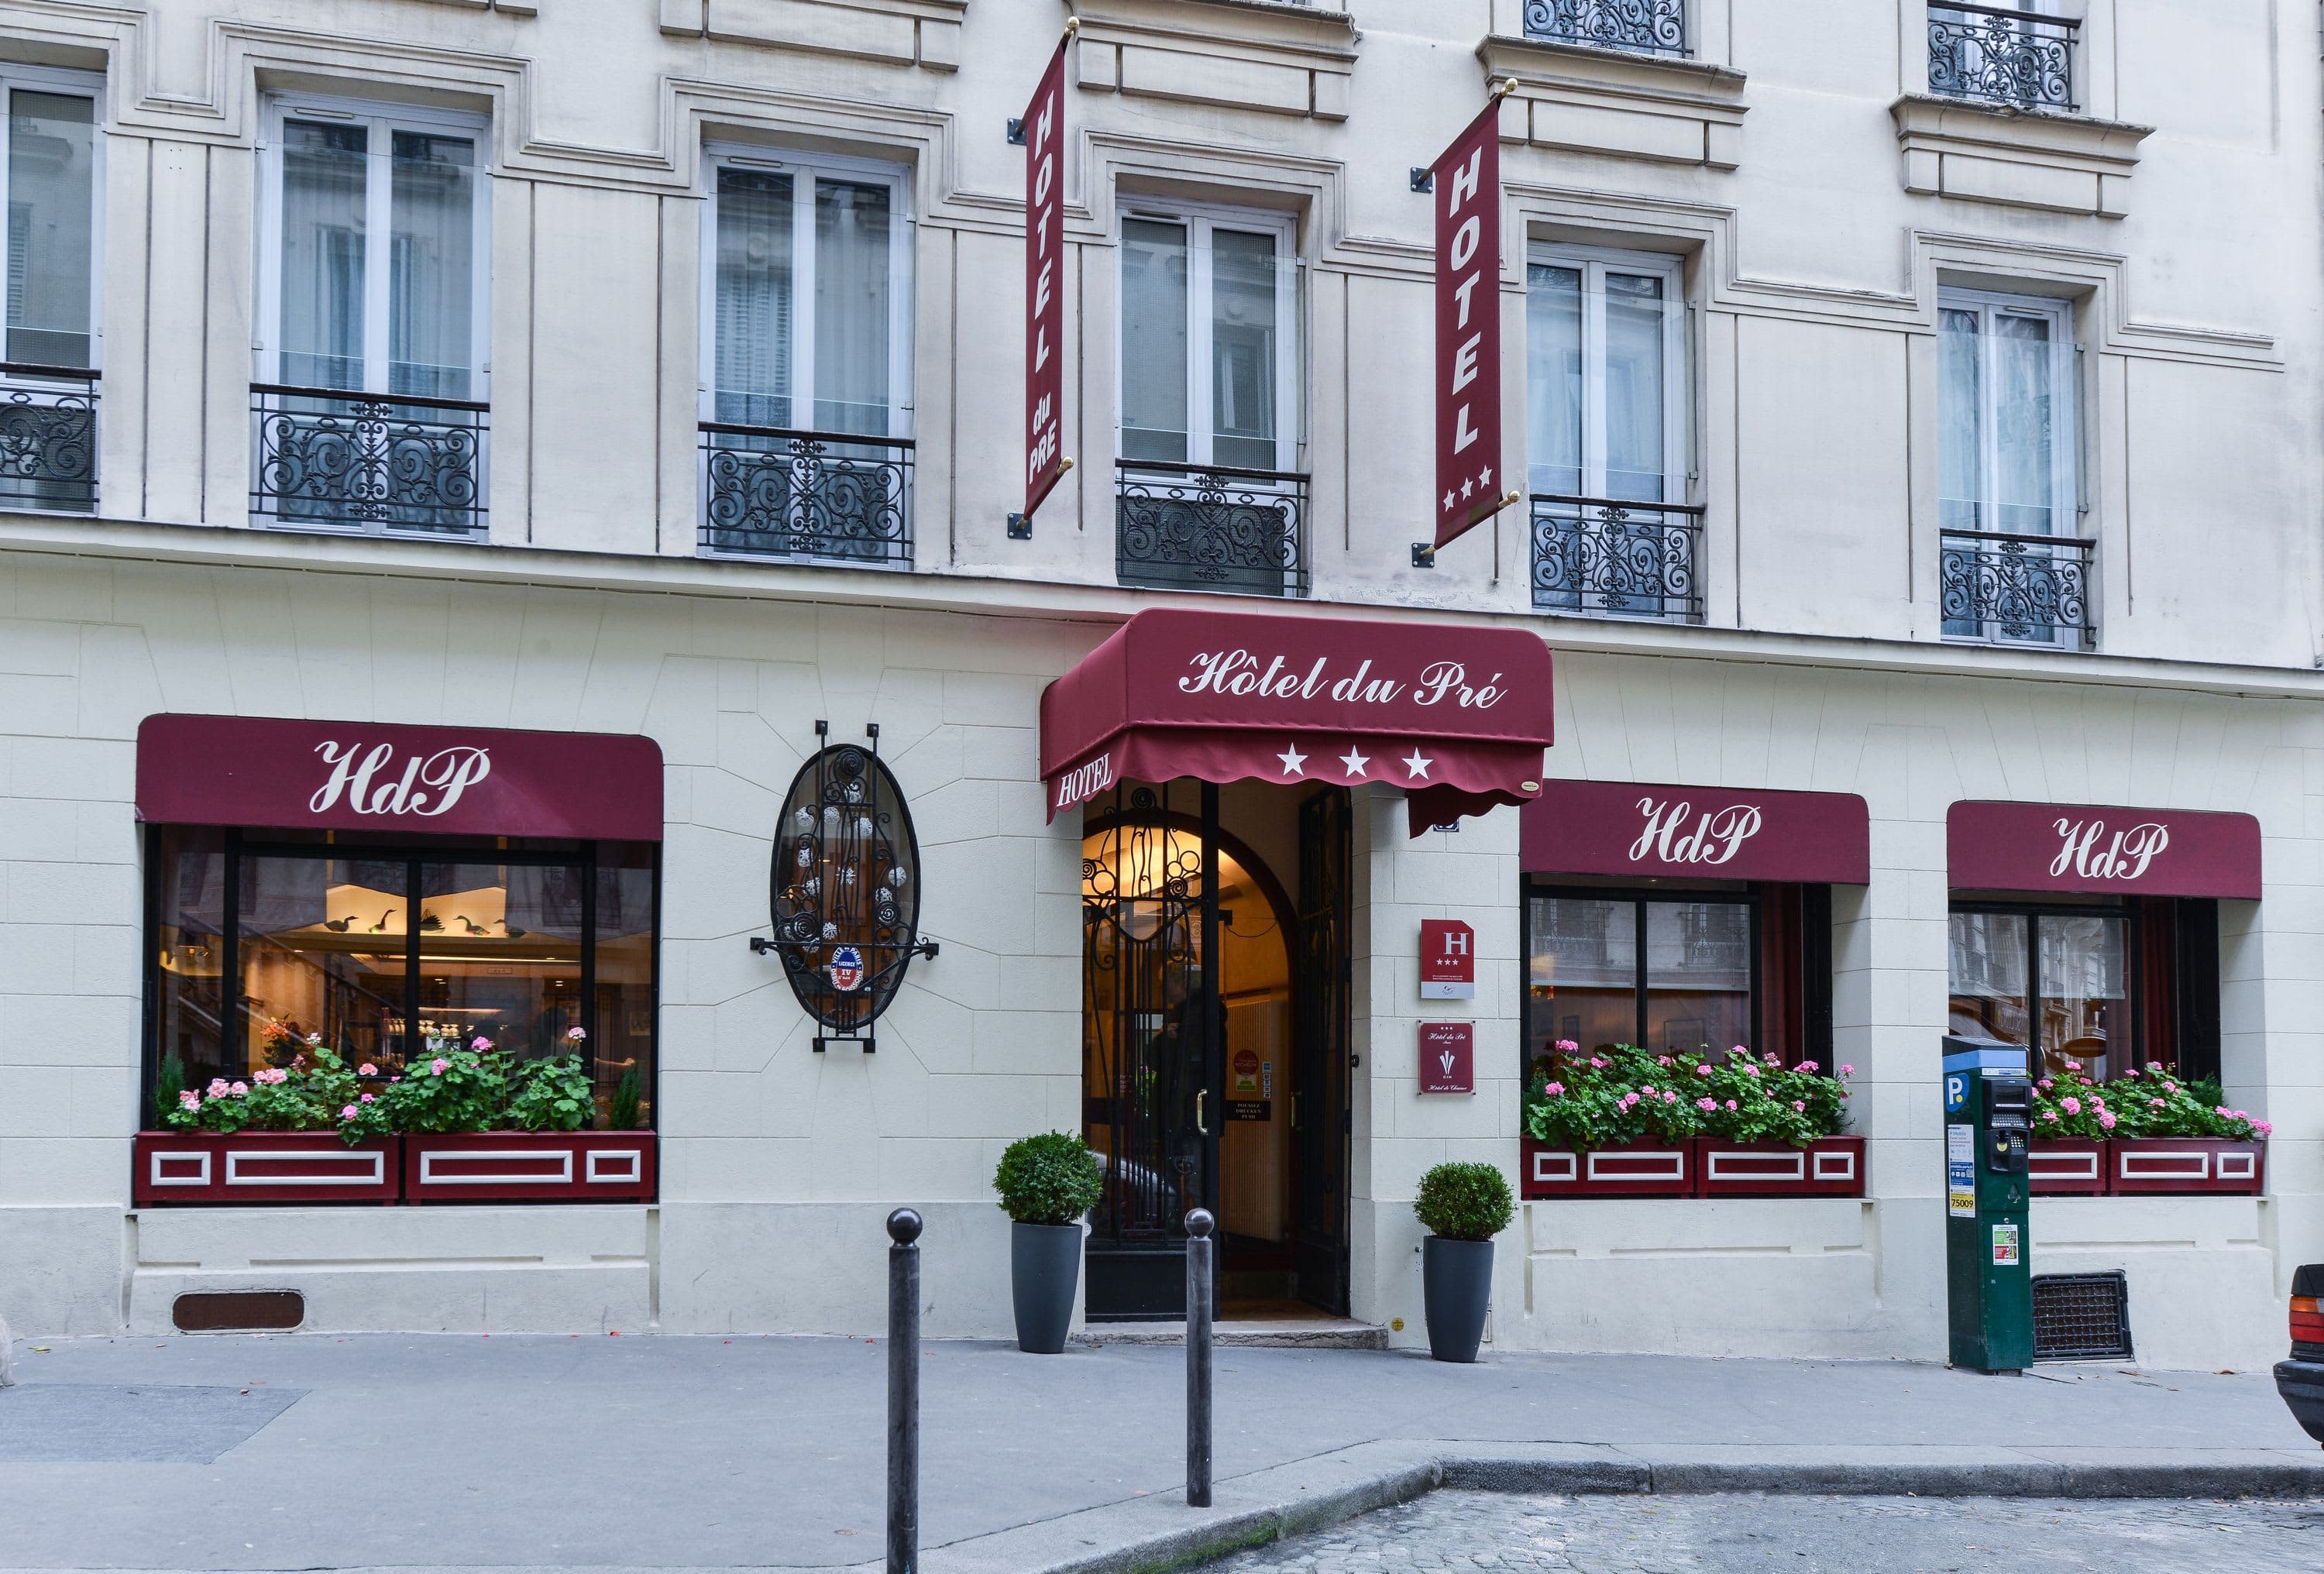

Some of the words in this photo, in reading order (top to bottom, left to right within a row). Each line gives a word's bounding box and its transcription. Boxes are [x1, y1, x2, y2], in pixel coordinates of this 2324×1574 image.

[1034, 90, 1054, 373] HOTEL
[1449, 145, 1481, 455] HOTEL
[1033, 391, 1051, 436] du
[1029, 418, 1057, 485] PRE
[1178, 649, 1329, 699] Hôtel
[1332, 659, 1407, 703] du
[1413, 661, 1509, 709] Pré
[309, 741, 491, 816] HdP
[1056, 752, 1112, 807] HOTEL
[1628, 797, 1762, 864] HdP
[2049, 817, 2169, 880] HdP
[832, 947, 844, 964] VILLE
[851, 947, 862, 965] PARIS
[1443, 933, 1469, 955] H
[1951, 1198, 1974, 1208] 75009
